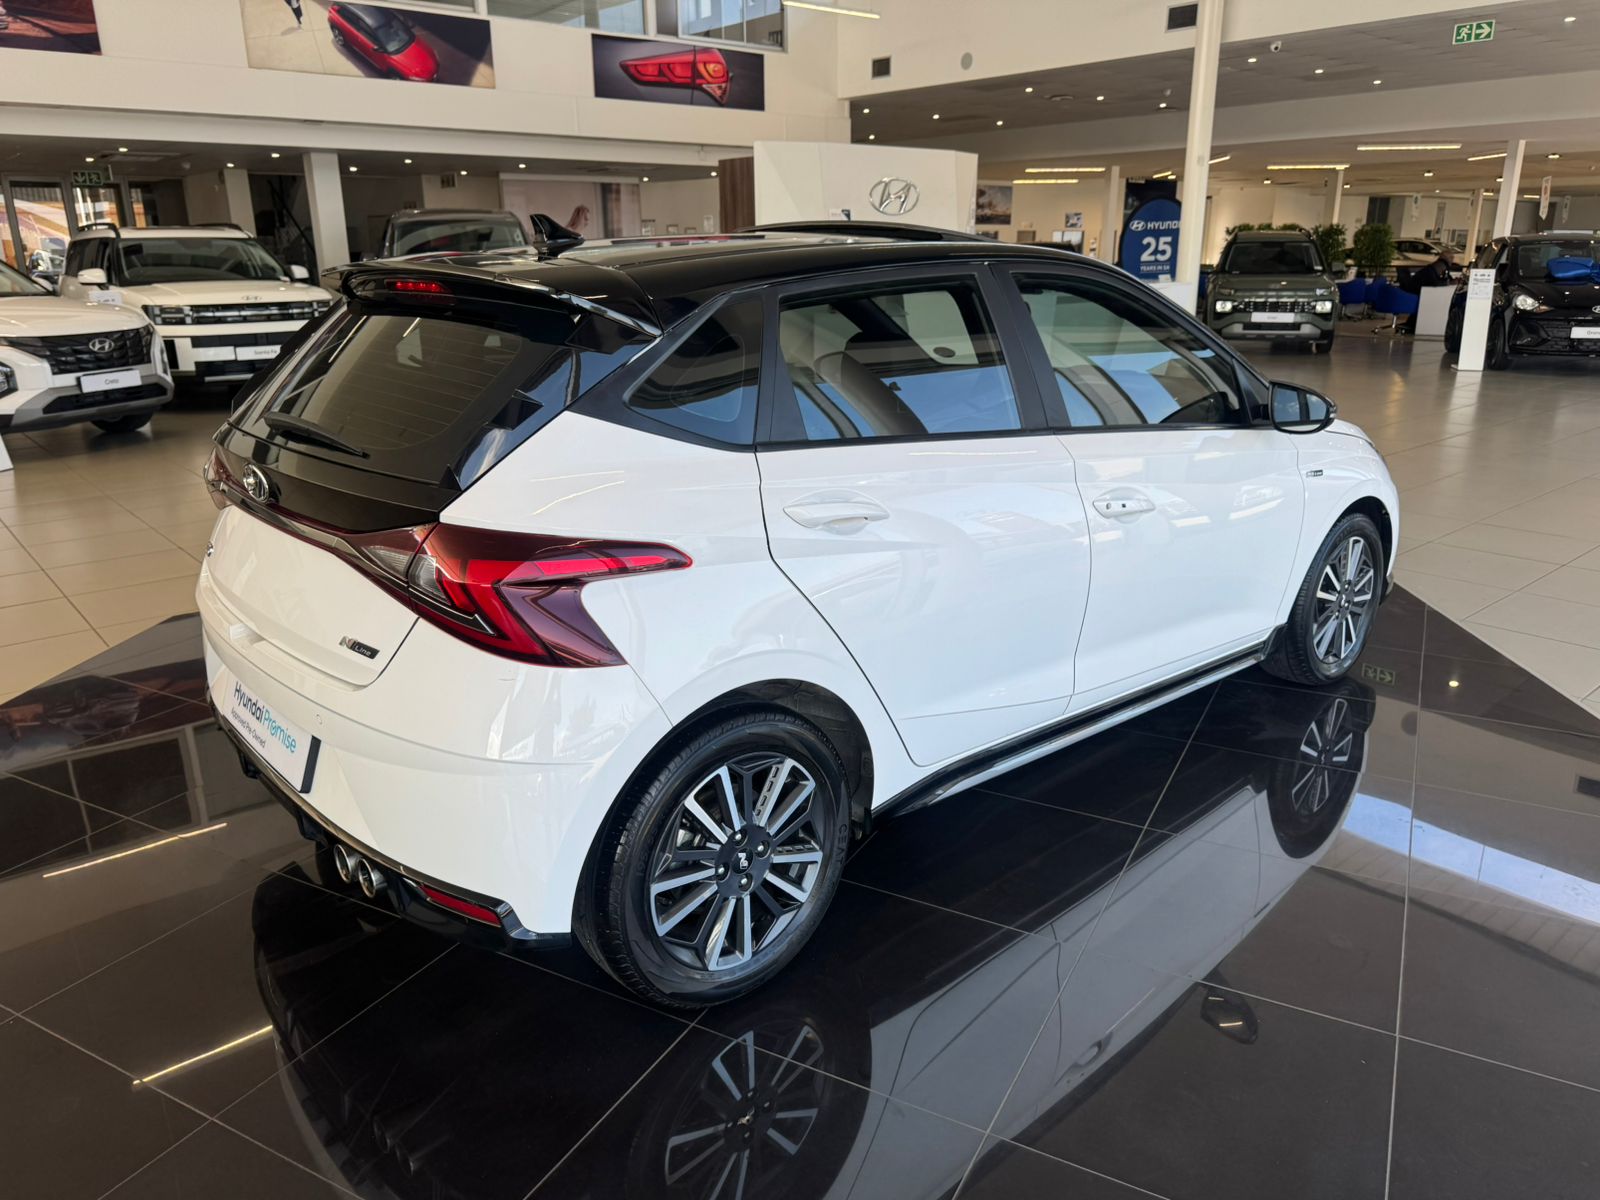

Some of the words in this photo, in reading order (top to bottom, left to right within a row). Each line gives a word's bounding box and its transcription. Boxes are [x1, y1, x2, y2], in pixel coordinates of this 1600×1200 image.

[1147, 220, 1181, 230] HYUND
[1140, 236, 1172, 262] 25
[354, 645, 372, 657] Line
[233, 681, 265, 723] Hyundai
